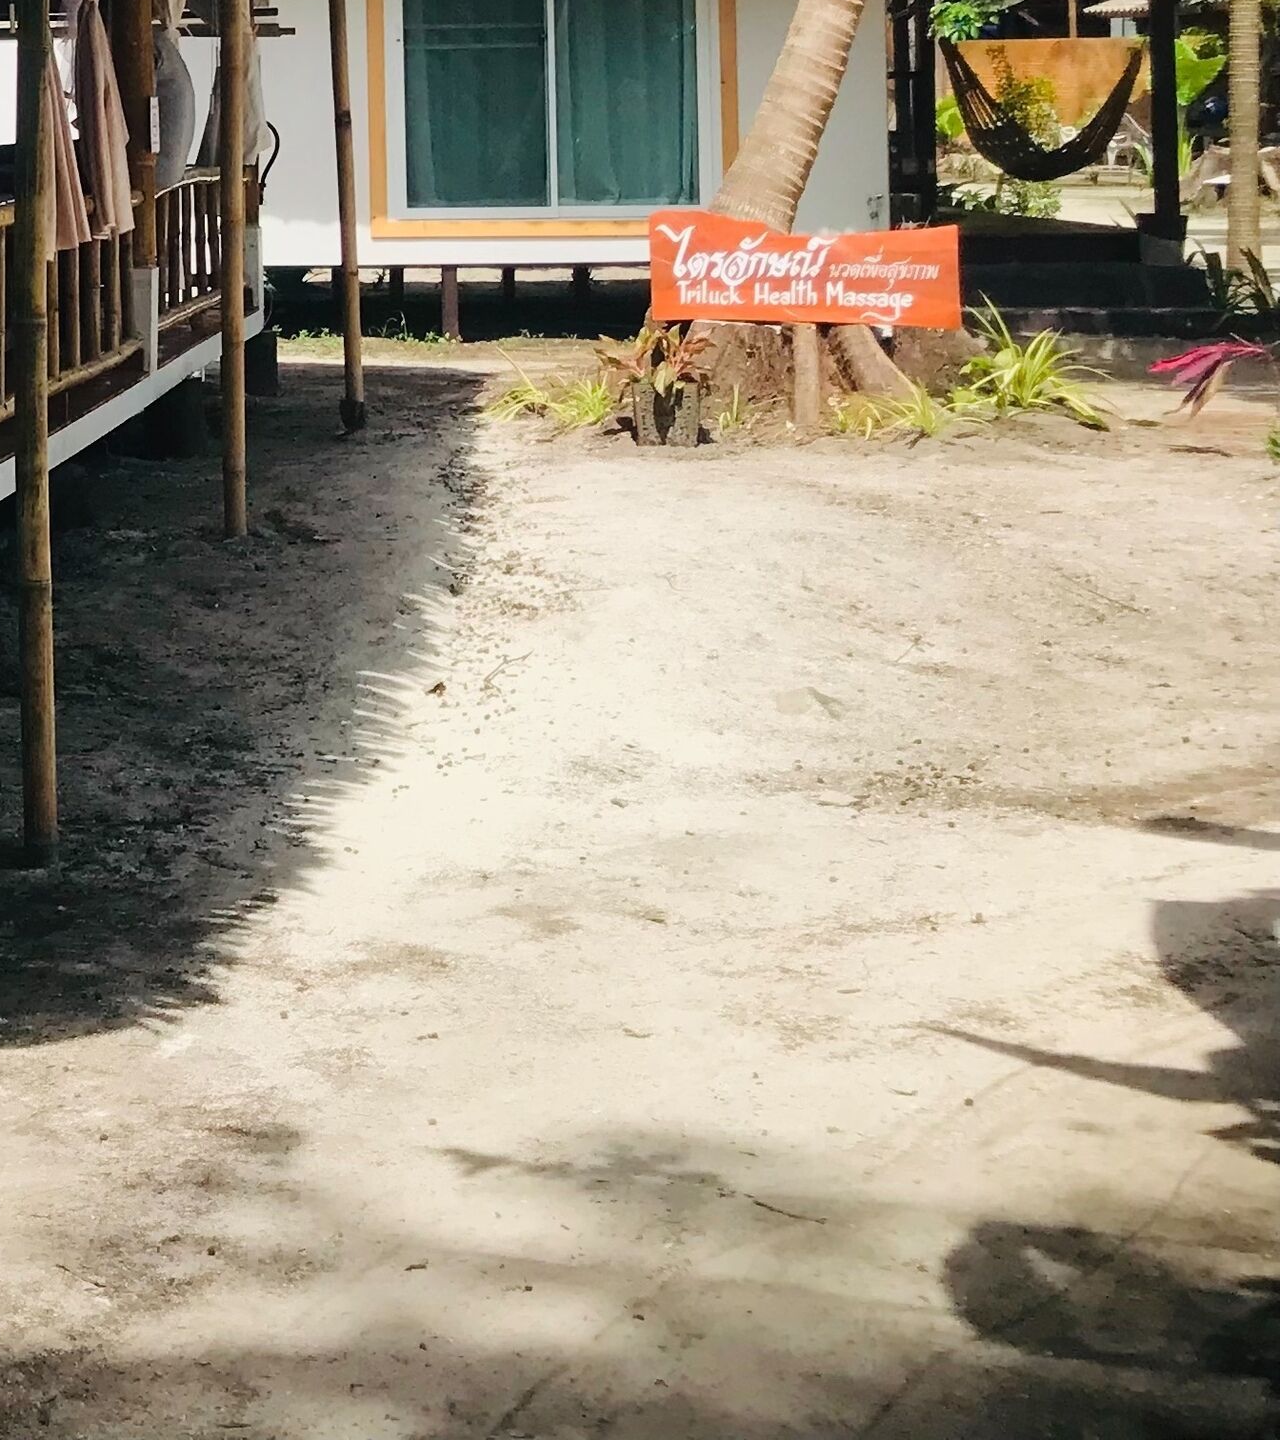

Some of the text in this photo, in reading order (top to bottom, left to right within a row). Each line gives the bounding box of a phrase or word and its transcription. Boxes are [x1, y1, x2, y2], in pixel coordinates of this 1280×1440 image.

[655, 224, 940, 291] ไตรลักษณ์ นวดเพื่อสุขภาพ
[675, 279, 913, 321] Triluck Health Massage
